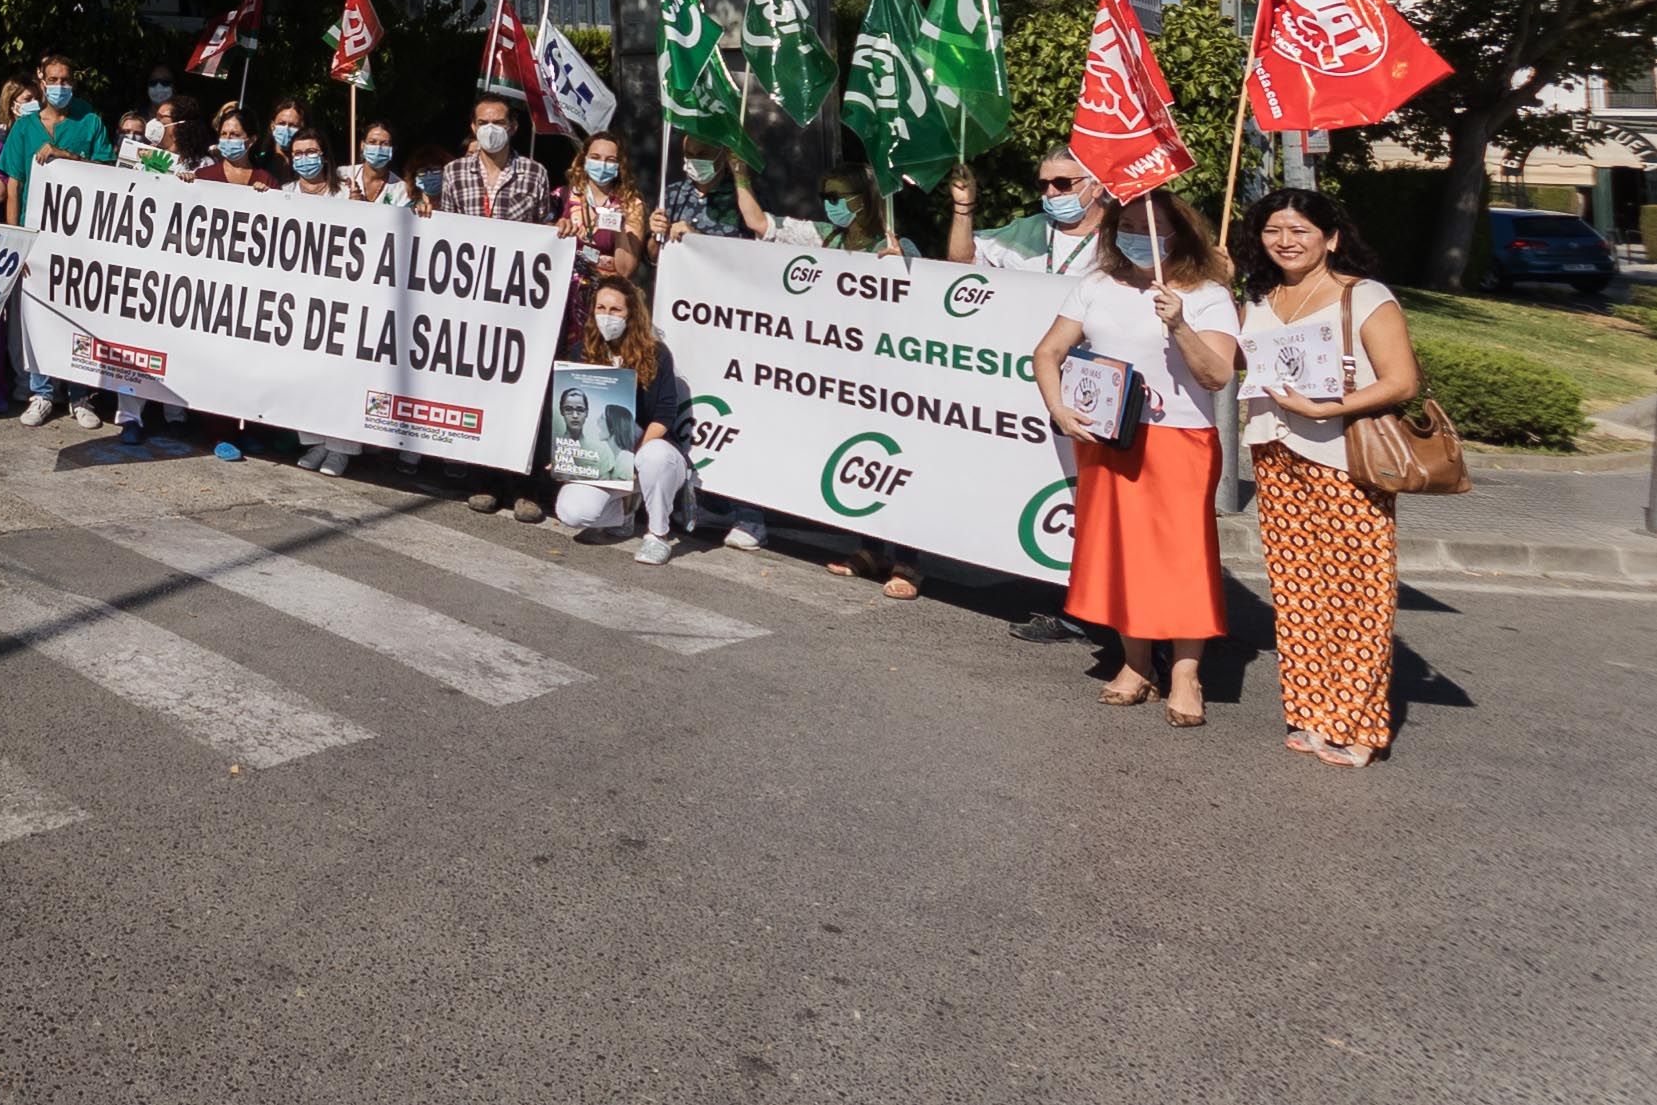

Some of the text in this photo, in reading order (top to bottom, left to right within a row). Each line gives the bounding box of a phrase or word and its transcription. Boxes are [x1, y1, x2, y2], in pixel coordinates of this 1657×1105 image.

[40, 182, 552, 310] NO MÁS AGRESIONES A LOS/LAS
[836, 272, 911, 303] CSIF
[49, 254, 526, 385] PROFESIONALES DE LA SALUD
[672, 299, 1037, 383] CONTRA LAS AGRESIO
[96, 343, 148, 369] CCOO
[397, 401, 462, 426] CCOO
[724, 359, 1047, 444] A PROFESIONALES
[364, 423, 419, 438] sociosanitarios
[420, 432, 430, 440] de
[365, 416, 399, 428] sindicato
[399, 421, 409, 429] de
[411, 423, 440, 434] sanidad
[447, 431, 481, 442] sectores
[555, 437, 581, 447] NADA
[676, 416, 740, 452] CSIF
[554, 455, 575, 464] UNA
[555, 447, 599, 461] JUSTIFICA
[839, 455, 914, 496] CSIF
